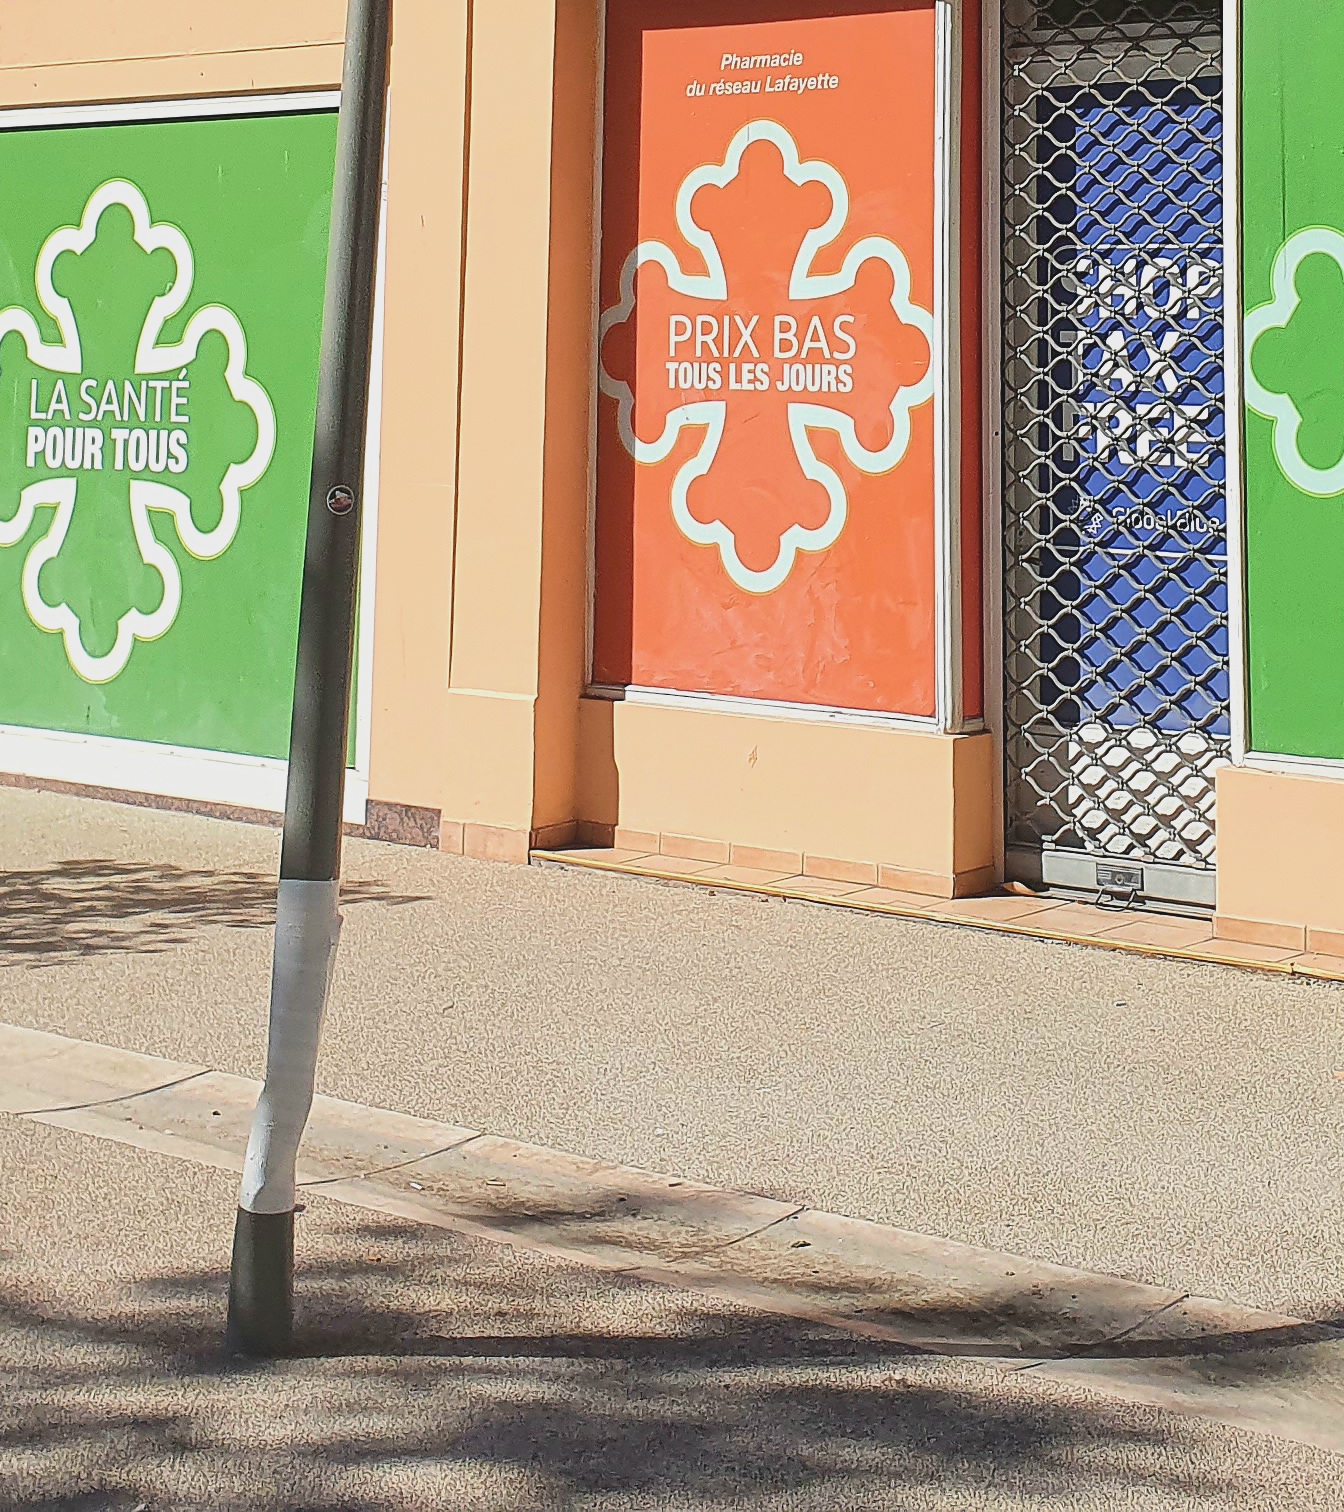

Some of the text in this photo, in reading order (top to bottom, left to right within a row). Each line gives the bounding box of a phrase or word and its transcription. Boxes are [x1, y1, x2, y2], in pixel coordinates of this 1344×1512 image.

[720, 49, 803, 70] Pharmacie
[686, 72, 839, 97] du réseau Lafayette
[669, 314, 857, 360] PRIX BAS
[30, 367, 190, 422] LA SANTÉ
[665, 361, 853, 392] TOUS LES JOURS
[26, 426, 189, 473] POUR TOUS
